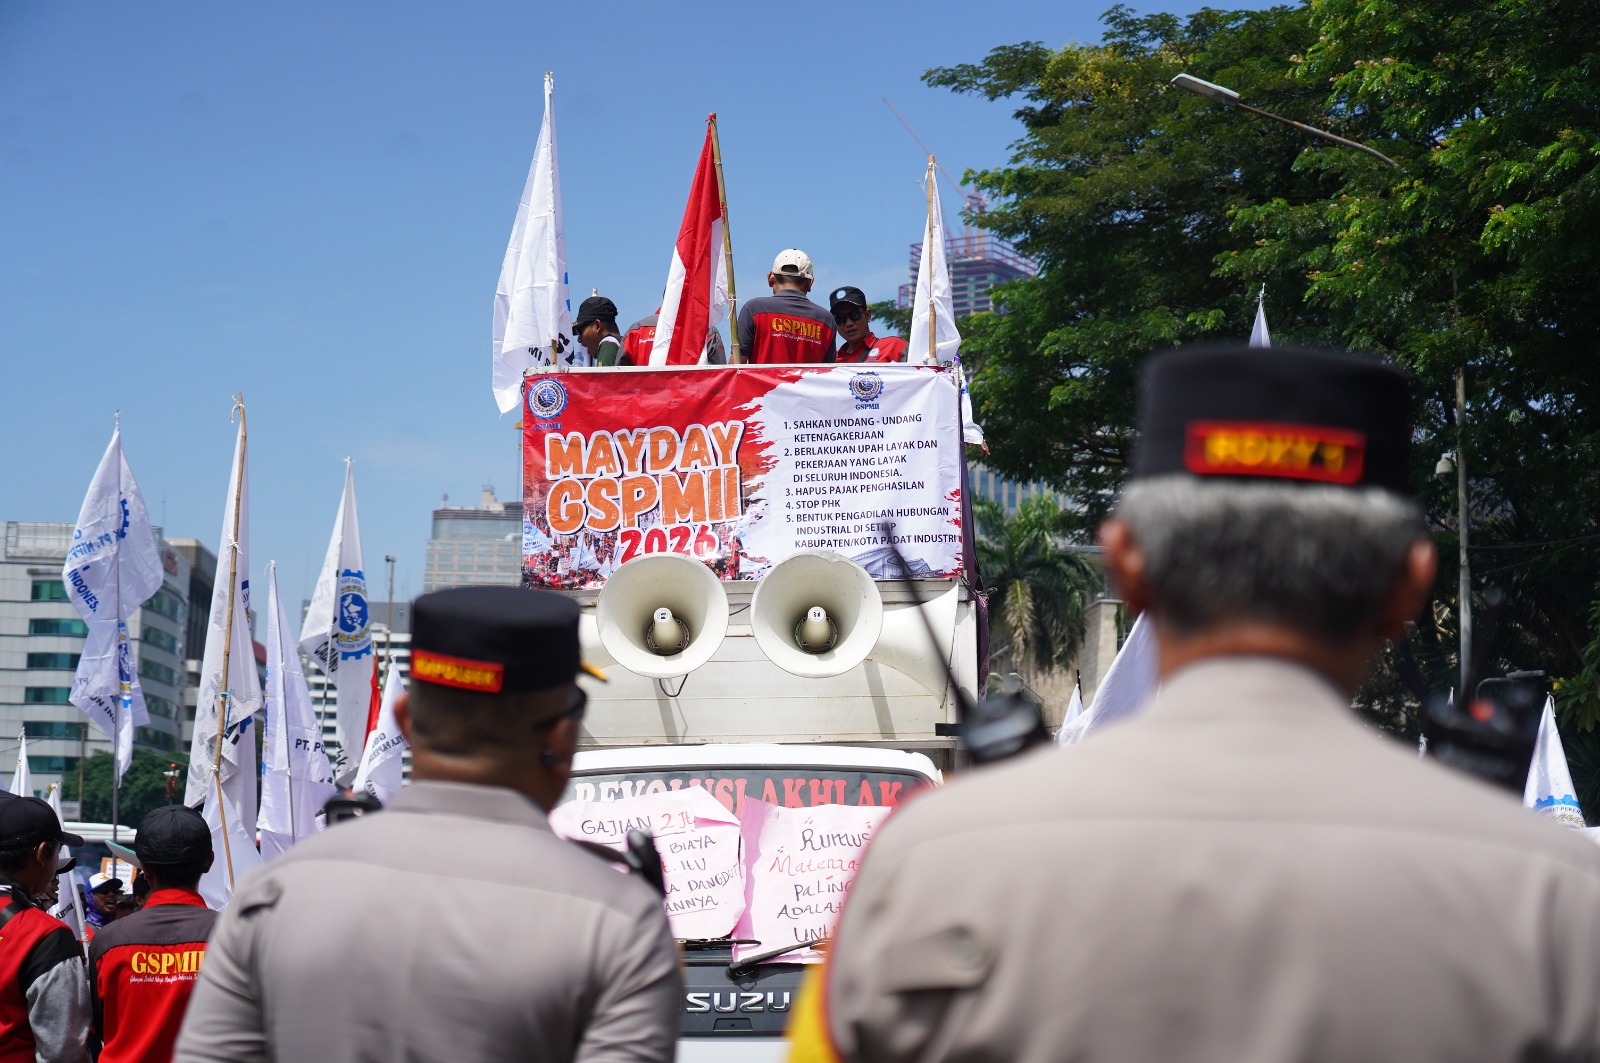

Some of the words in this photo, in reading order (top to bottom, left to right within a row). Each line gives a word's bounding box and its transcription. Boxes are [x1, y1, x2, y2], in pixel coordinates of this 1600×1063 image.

[784, 421, 792, 430] 1.
[793, 419, 831, 429] SAHKAN
[834, 417, 874, 428] UNDANG
[882, 414, 922, 426] UNDANG
[794, 430, 884, 443] KETENAGAKERJAAN
[548, 423, 742, 477] MAYDAY
[784, 448, 792, 456] 2.
[794, 445, 856, 456] BERLAKUKAN
[858, 443, 883, 454] UPAH
[886, 441, 915, 451] LAYAK
[917, 440, 938, 449] DAN
[795, 458, 848, 469] PEKERJAAN
[850, 457, 875, 467] YANG
[877, 454, 907, 465] LAYAK
[794, 474, 803, 482] DI
[805, 471, 848, 482] SELURUH
[850, 468, 902, 480] INDONESIA.
[786, 488, 793, 496] 3.
[795, 486, 827, 496] HAPUS
[829, 484, 858, 494] PAJAK
[860, 481, 924, 492] PENGHASILAN
[548, 465, 741, 533] GSPMII
[785, 501, 794, 509] 4.
[796, 500, 819, 509] STOP
[822, 499, 841, 508] PHK
[786, 514, 794, 523] 5.
[796, 512, 833, 522] BENTUK
[836, 509, 894, 521] PENGADILAN
[896, 507, 949, 517] HUBUNGAN
[797, 526, 851, 535] INDUSTRIAL
[854, 524, 863, 533] DI
[619, 523, 718, 565] 2026
[795, 536, 878, 548] KABUPATEN/KOTA
[881, 535, 912, 545] PADAT
[914, 534, 956, 543] INDUSTRI
[582, 816, 651, 836] GAJIAN
[660, 813, 673, 830] 2
[670, 835, 716, 854] BIAYA
[132, 951, 205, 974] GSPMII
[686, 991, 791, 1013] SUZU
